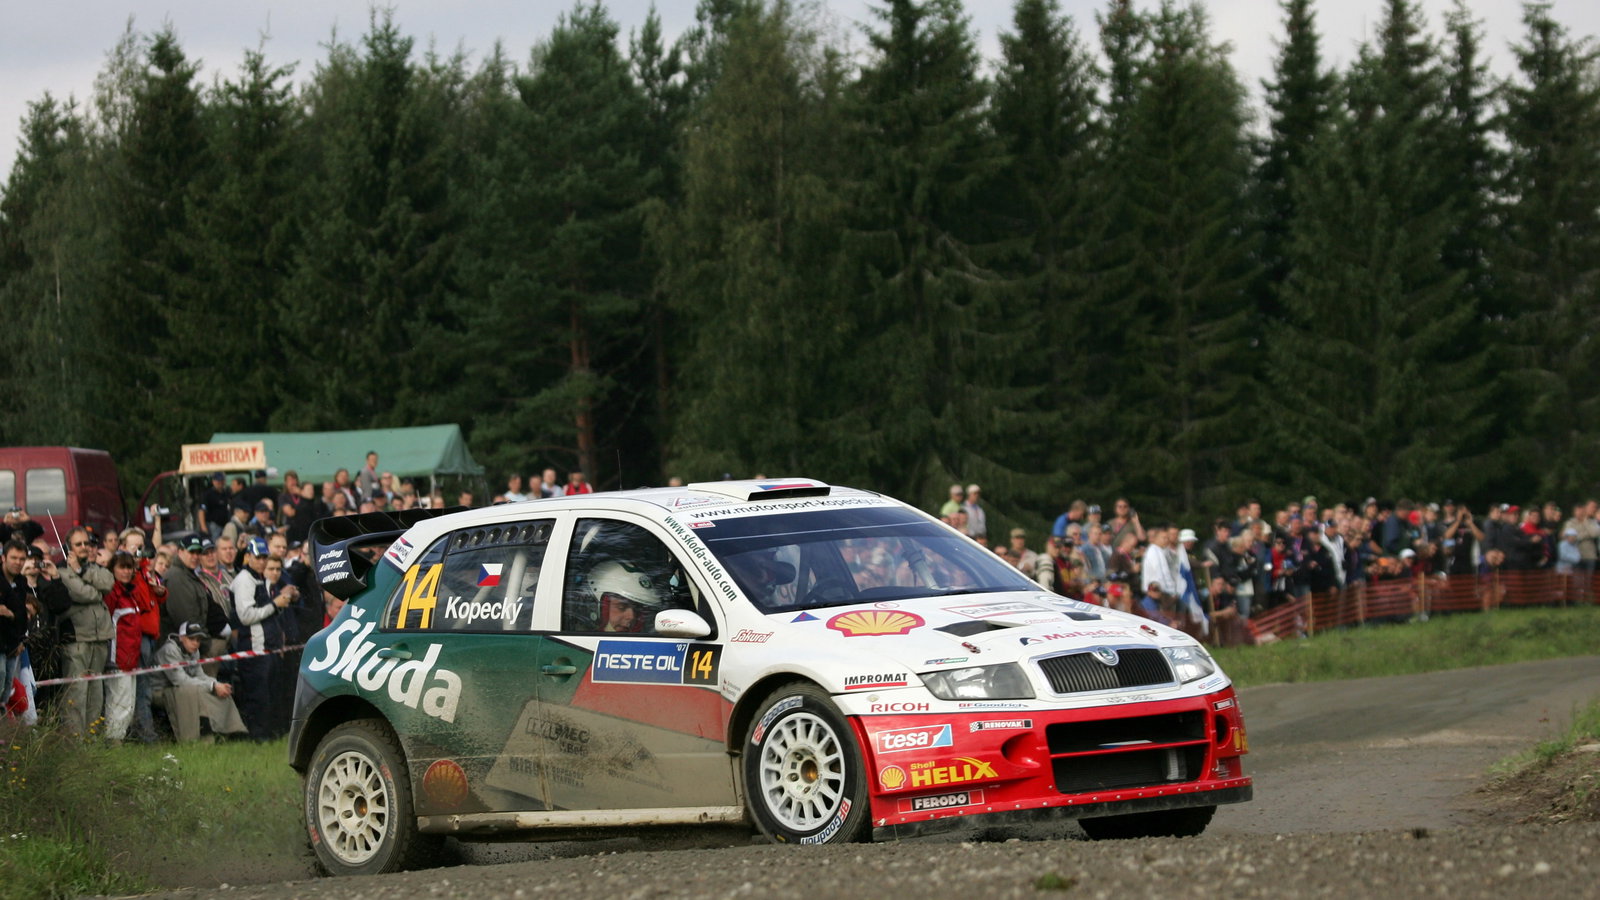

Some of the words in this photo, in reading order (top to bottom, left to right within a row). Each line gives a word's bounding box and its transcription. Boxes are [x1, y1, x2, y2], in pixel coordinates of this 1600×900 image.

[319, 560, 347, 572] LOCTITE
[664, 515, 738, 602] www.skoda-auto.com
[396, 563, 443, 629] 14
[444, 596, 523, 625] Kopecký
[731, 628, 775, 643] Sakurai
[1041, 629, 1129, 641] Matador
[308, 605, 463, 724] Škoda
[597, 653, 653, 670] NESTE
[655, 655, 681, 672] OIL
[691, 650, 714, 680] 14
[844, 673, 908, 686] IMPROMAT
[870, 702, 930, 713] RICOH
[984, 720, 1023, 730] RENOVAK
[881, 731, 929, 749] tesa
[910, 761, 935, 770] Shell
[910, 757, 999, 788] HELIX
[914, 794, 968, 810] FERODO
